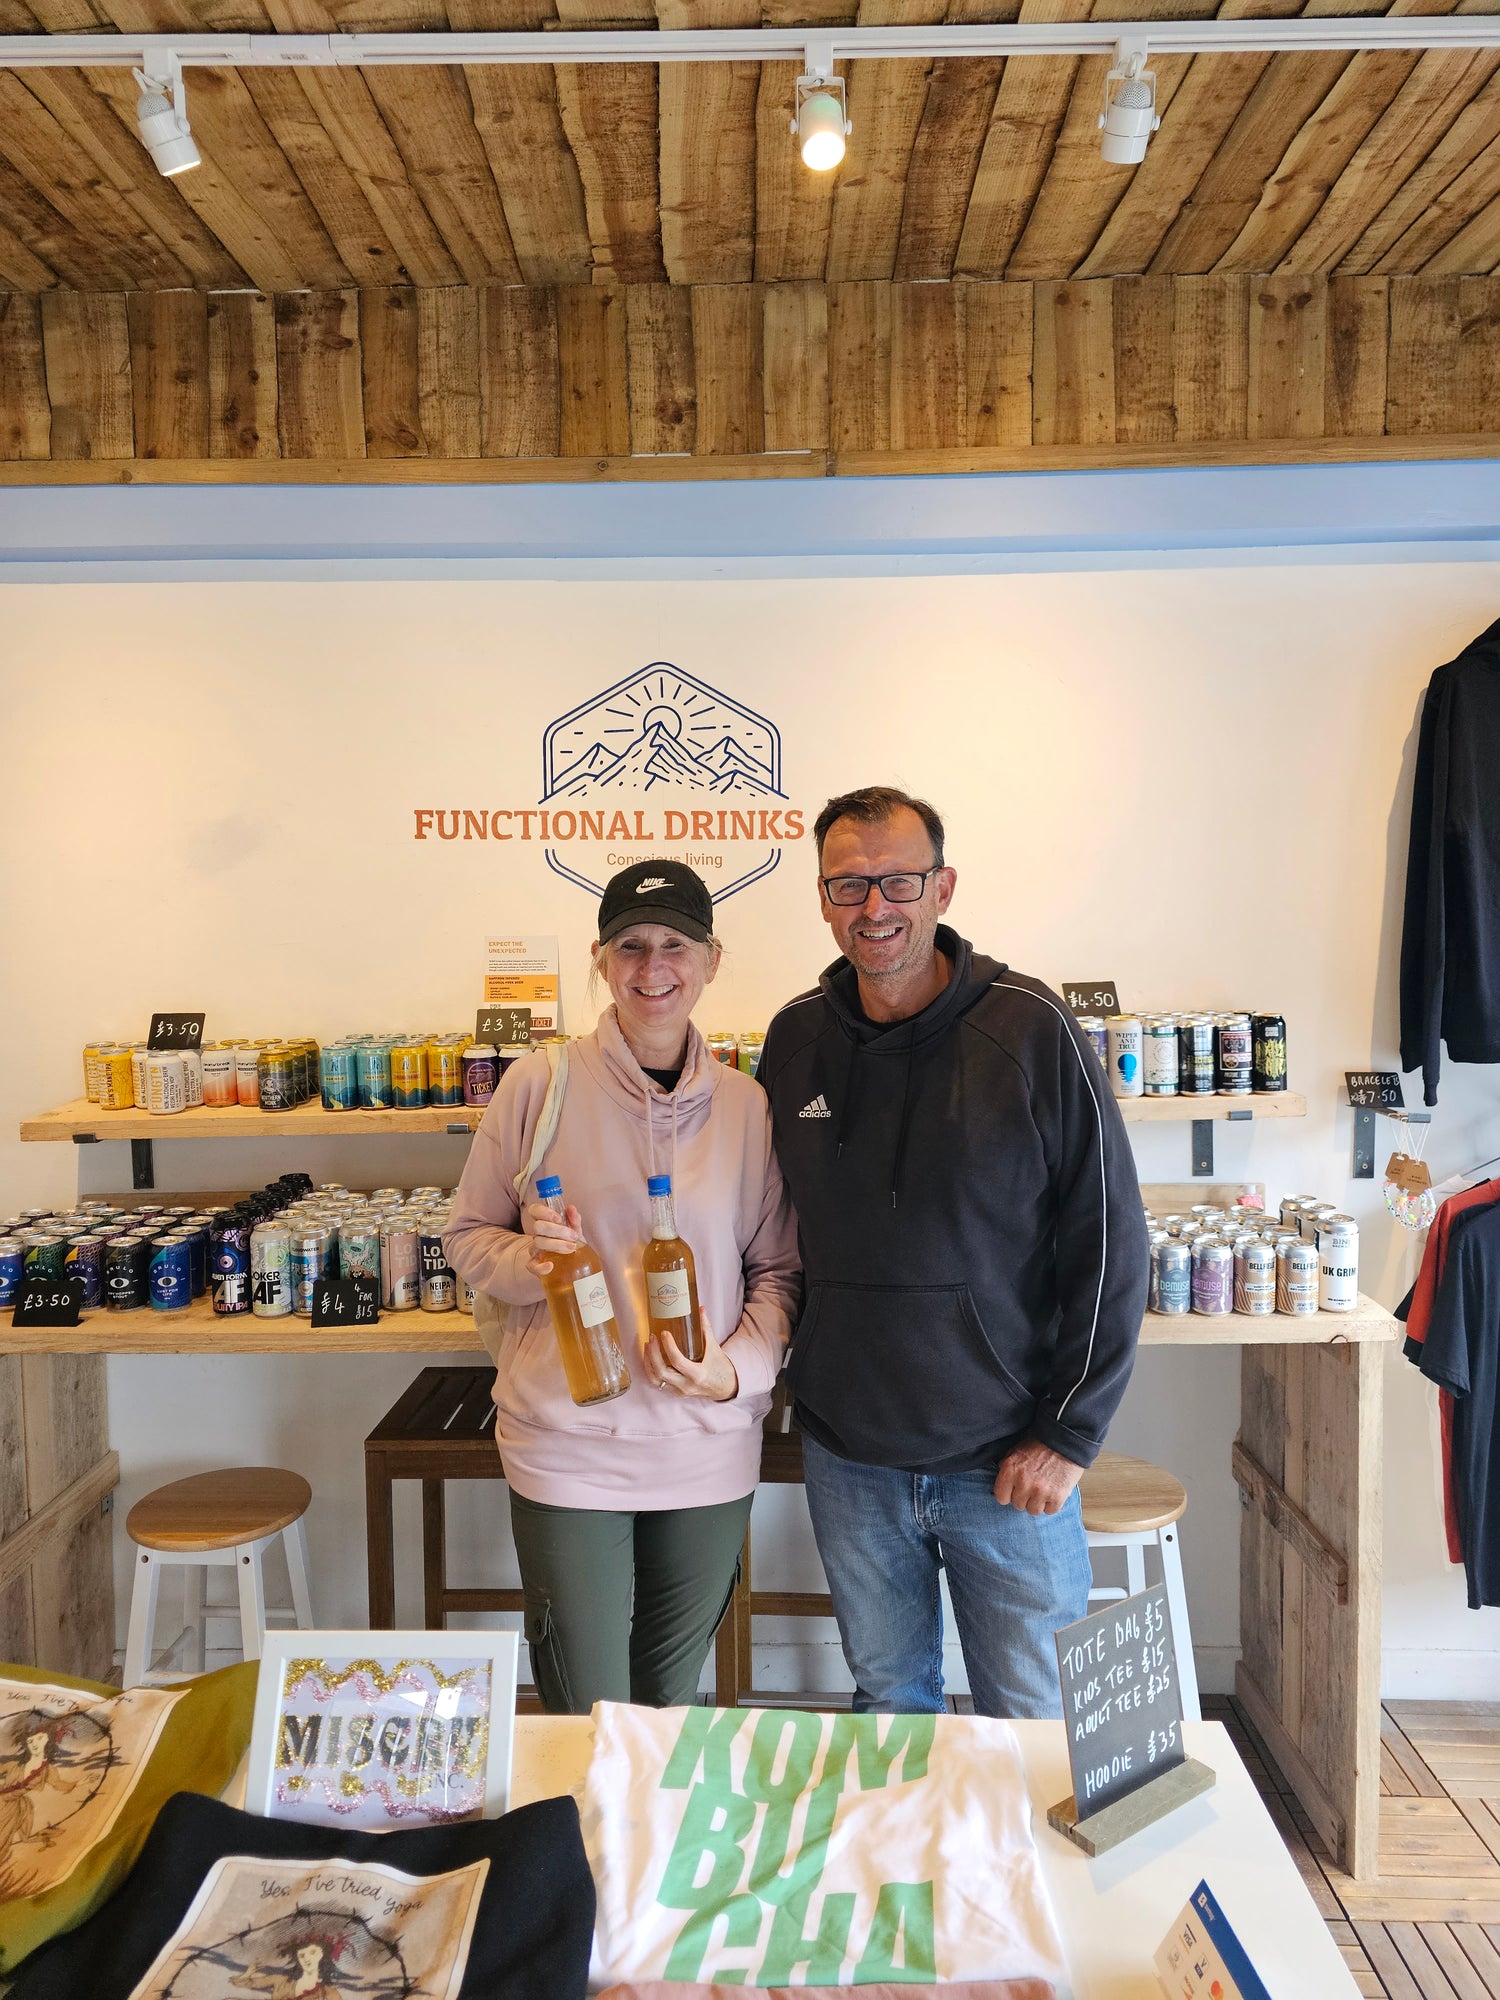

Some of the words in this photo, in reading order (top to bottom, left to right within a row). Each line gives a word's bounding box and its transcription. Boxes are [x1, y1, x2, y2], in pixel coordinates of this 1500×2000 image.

[413, 809, 654, 841] FUNCTIONAL
[664, 809, 805, 841] DRINKS
[685, 852, 723, 869] living
[642, 878, 666, 887] NIKE
[510, 1011, 518, 1021] 4
[532, 1018, 551, 1027] TICKET
[482, 1018, 504, 1032] £3
[511, 1031, 529, 1041] £10
[150, 1066, 163, 1110] FUNGTN
[471, 1080, 494, 1095] TICKET
[798, 1109, 832, 1118] adidas
[394, 1243, 413, 1255] LO
[423, 1245, 442, 1257] LO
[395, 1254, 418, 1268] TID
[423, 1258, 448, 1270] TID
[226, 1271, 248, 1280] FORM
[252, 1271, 280, 1281] OKER
[1322, 1265, 1335, 1276] UK
[1336, 1267, 1357, 1277] GRIM
[213, 1280, 245, 1304] AF
[252, 1281, 281, 1305] AF
[354, 1283, 361, 1293] 4
[429, 1281, 451, 1291] NEIPA
[320, 1291, 345, 1315] £4
[358, 1292, 373, 1302] FOR
[235, 1301, 249, 1311] IPA
[355, 1304, 374, 1320] £15
[1062, 1628, 1105, 1680] TOTE
[1115, 1613, 1141, 1648] BAG
[1144, 1598, 1164, 1643] £5
[1073, 1676, 1101, 1714] KIDS
[1105, 1658, 1134, 1689] TEE
[1141, 1636, 1166, 1674] £15
[1075, 1698, 1112, 1742] ADULT
[1115, 1684, 1142, 1714] TEE
[1146, 1664, 1170, 1704] £25
[658, 1705, 937, 1799] KOM
[1085, 1746, 1134, 1799] HOODIE
[1147, 1719, 1177, 1763] £35
[655, 1781, 840, 1910] BU
[303, 1874, 336, 1892] I've
[336, 1875, 382, 1900] tried
[383, 1896, 424, 1917] yoga
[662, 1879, 937, 1987] CHA
[1183, 1928, 1193, 1950] VISA
